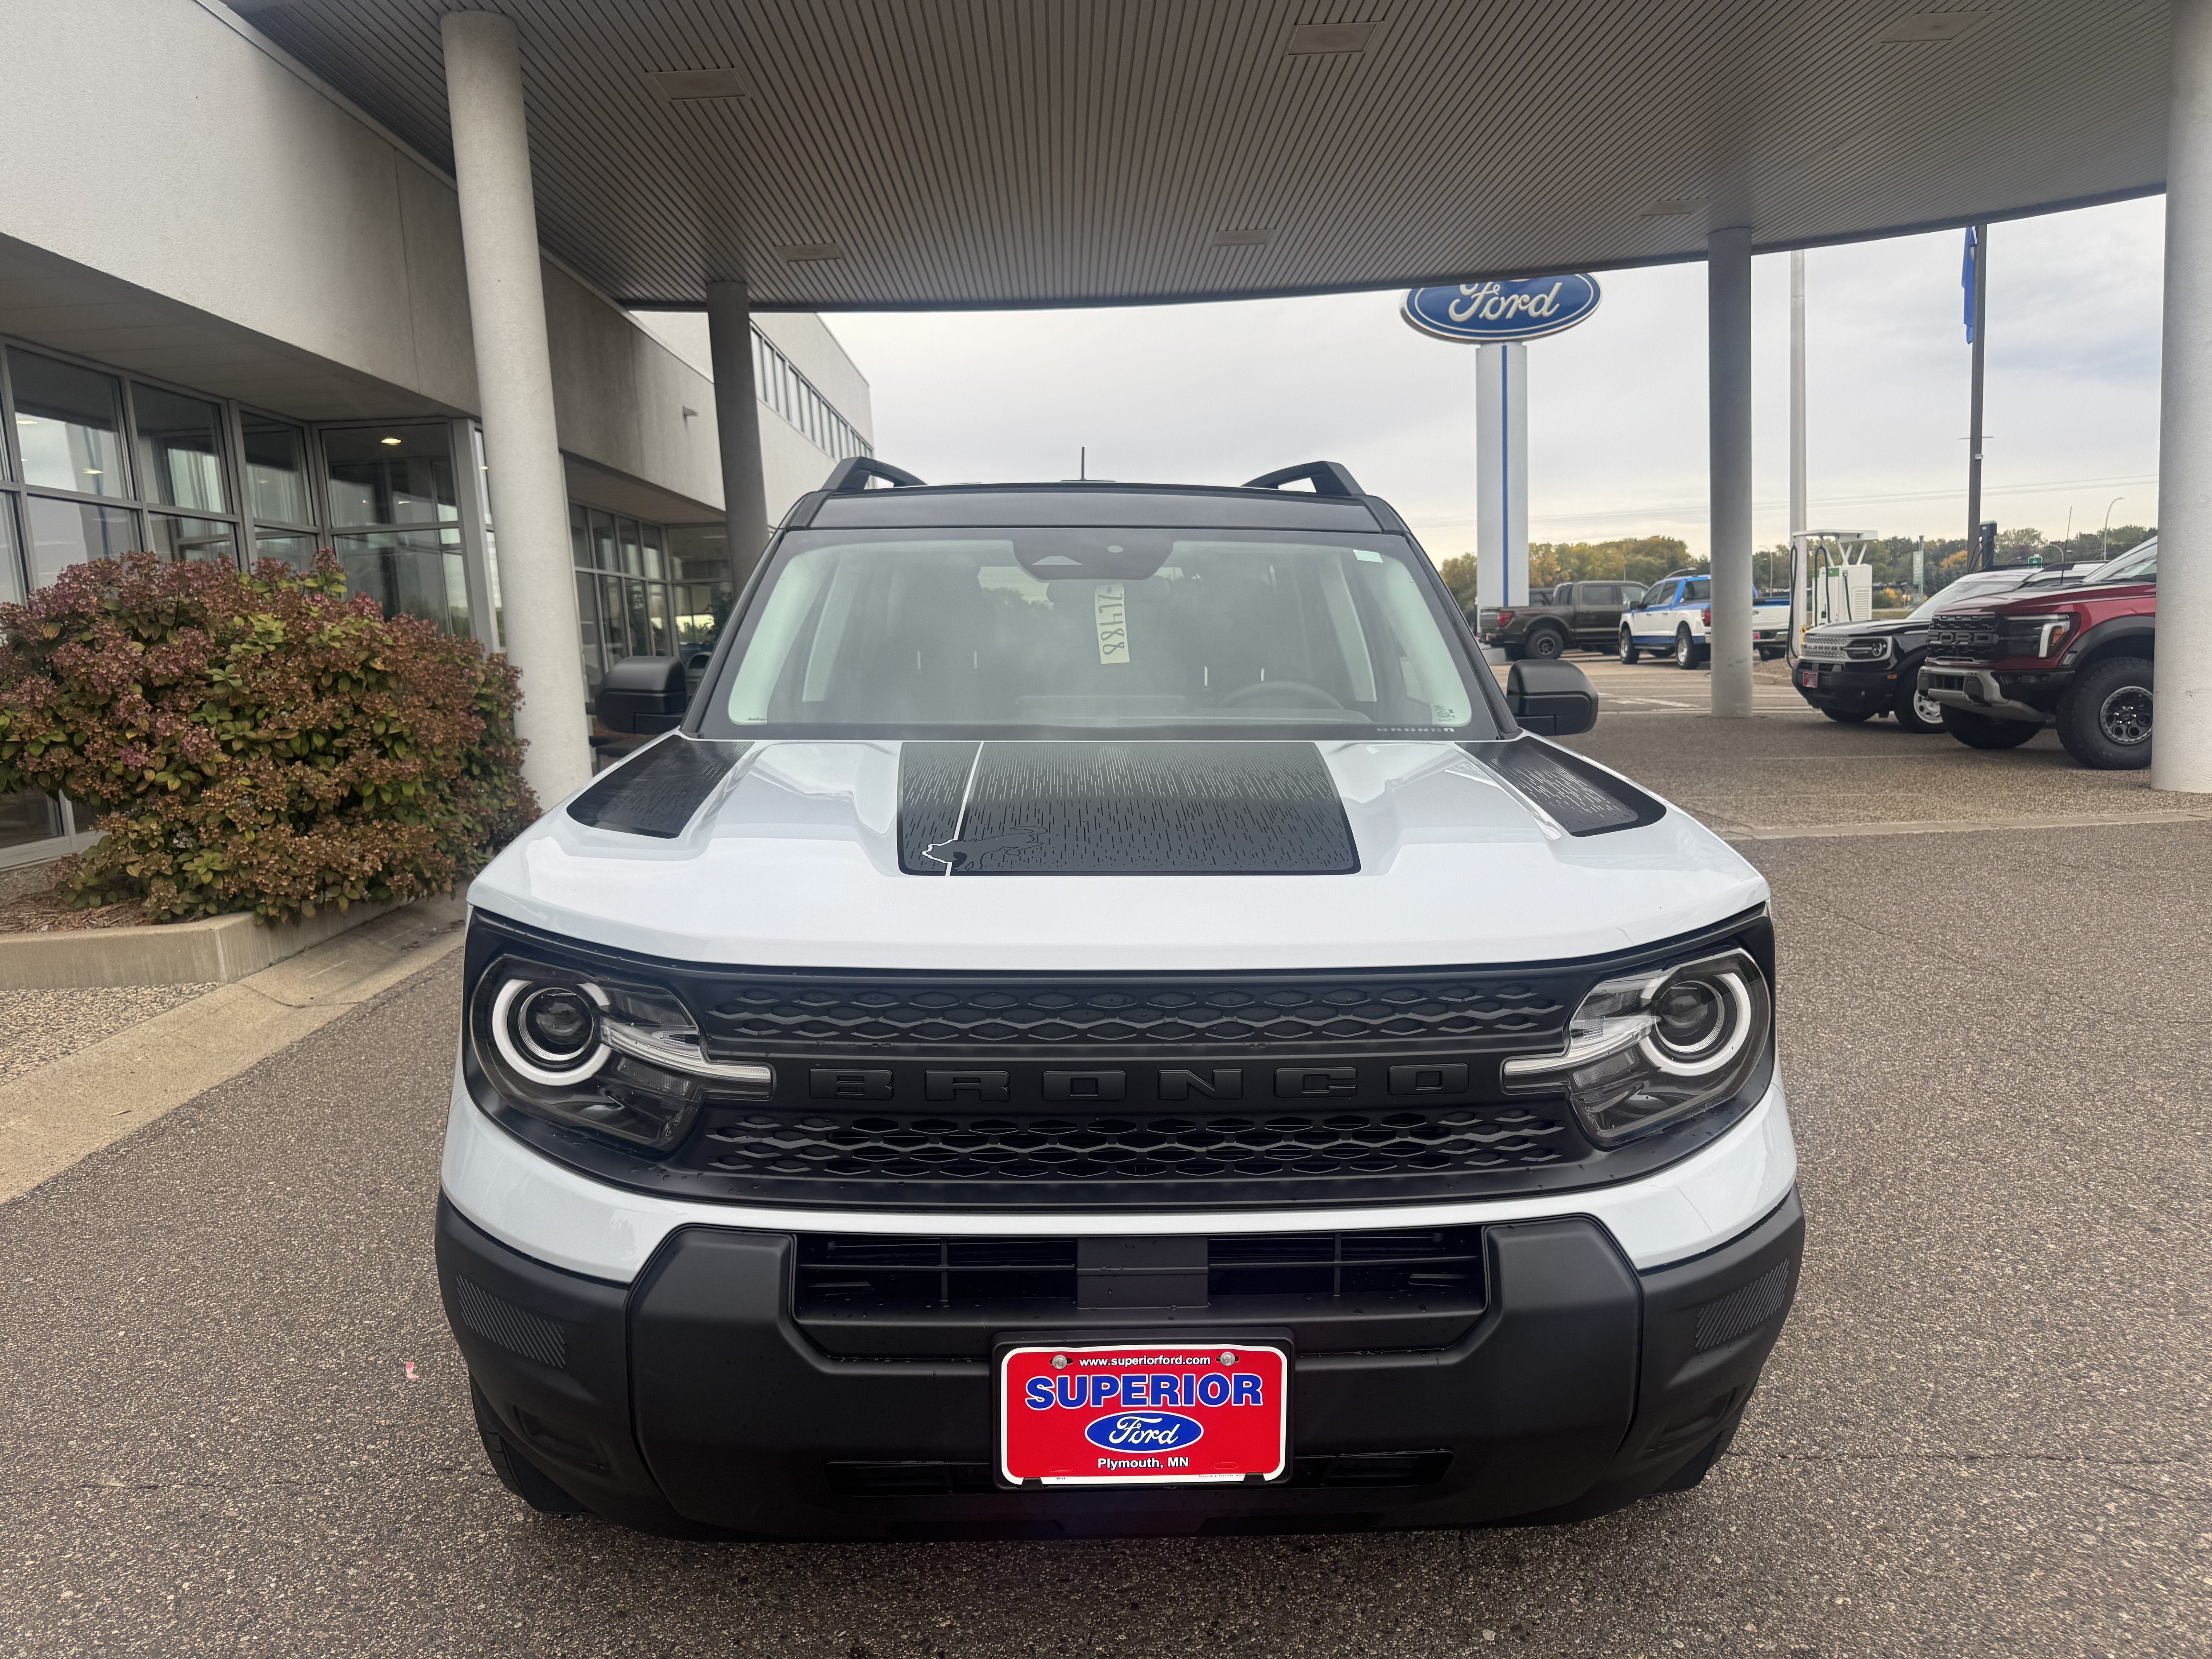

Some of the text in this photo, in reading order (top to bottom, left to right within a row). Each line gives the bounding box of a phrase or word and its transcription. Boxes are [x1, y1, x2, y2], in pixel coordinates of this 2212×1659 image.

[1448, 278, 1563, 322] Ford
[1926, 632, 1994, 645] FORD
[808, 1063, 1469, 1101] BRONCO
[1079, 1355, 1211, 1368] www.superiorford.com
[1025, 1372, 1264, 1411] SUPERIOR
[1109, 1416, 1180, 1444] Ford
[1097, 1456, 1189, 1471] Plymouth, MN
